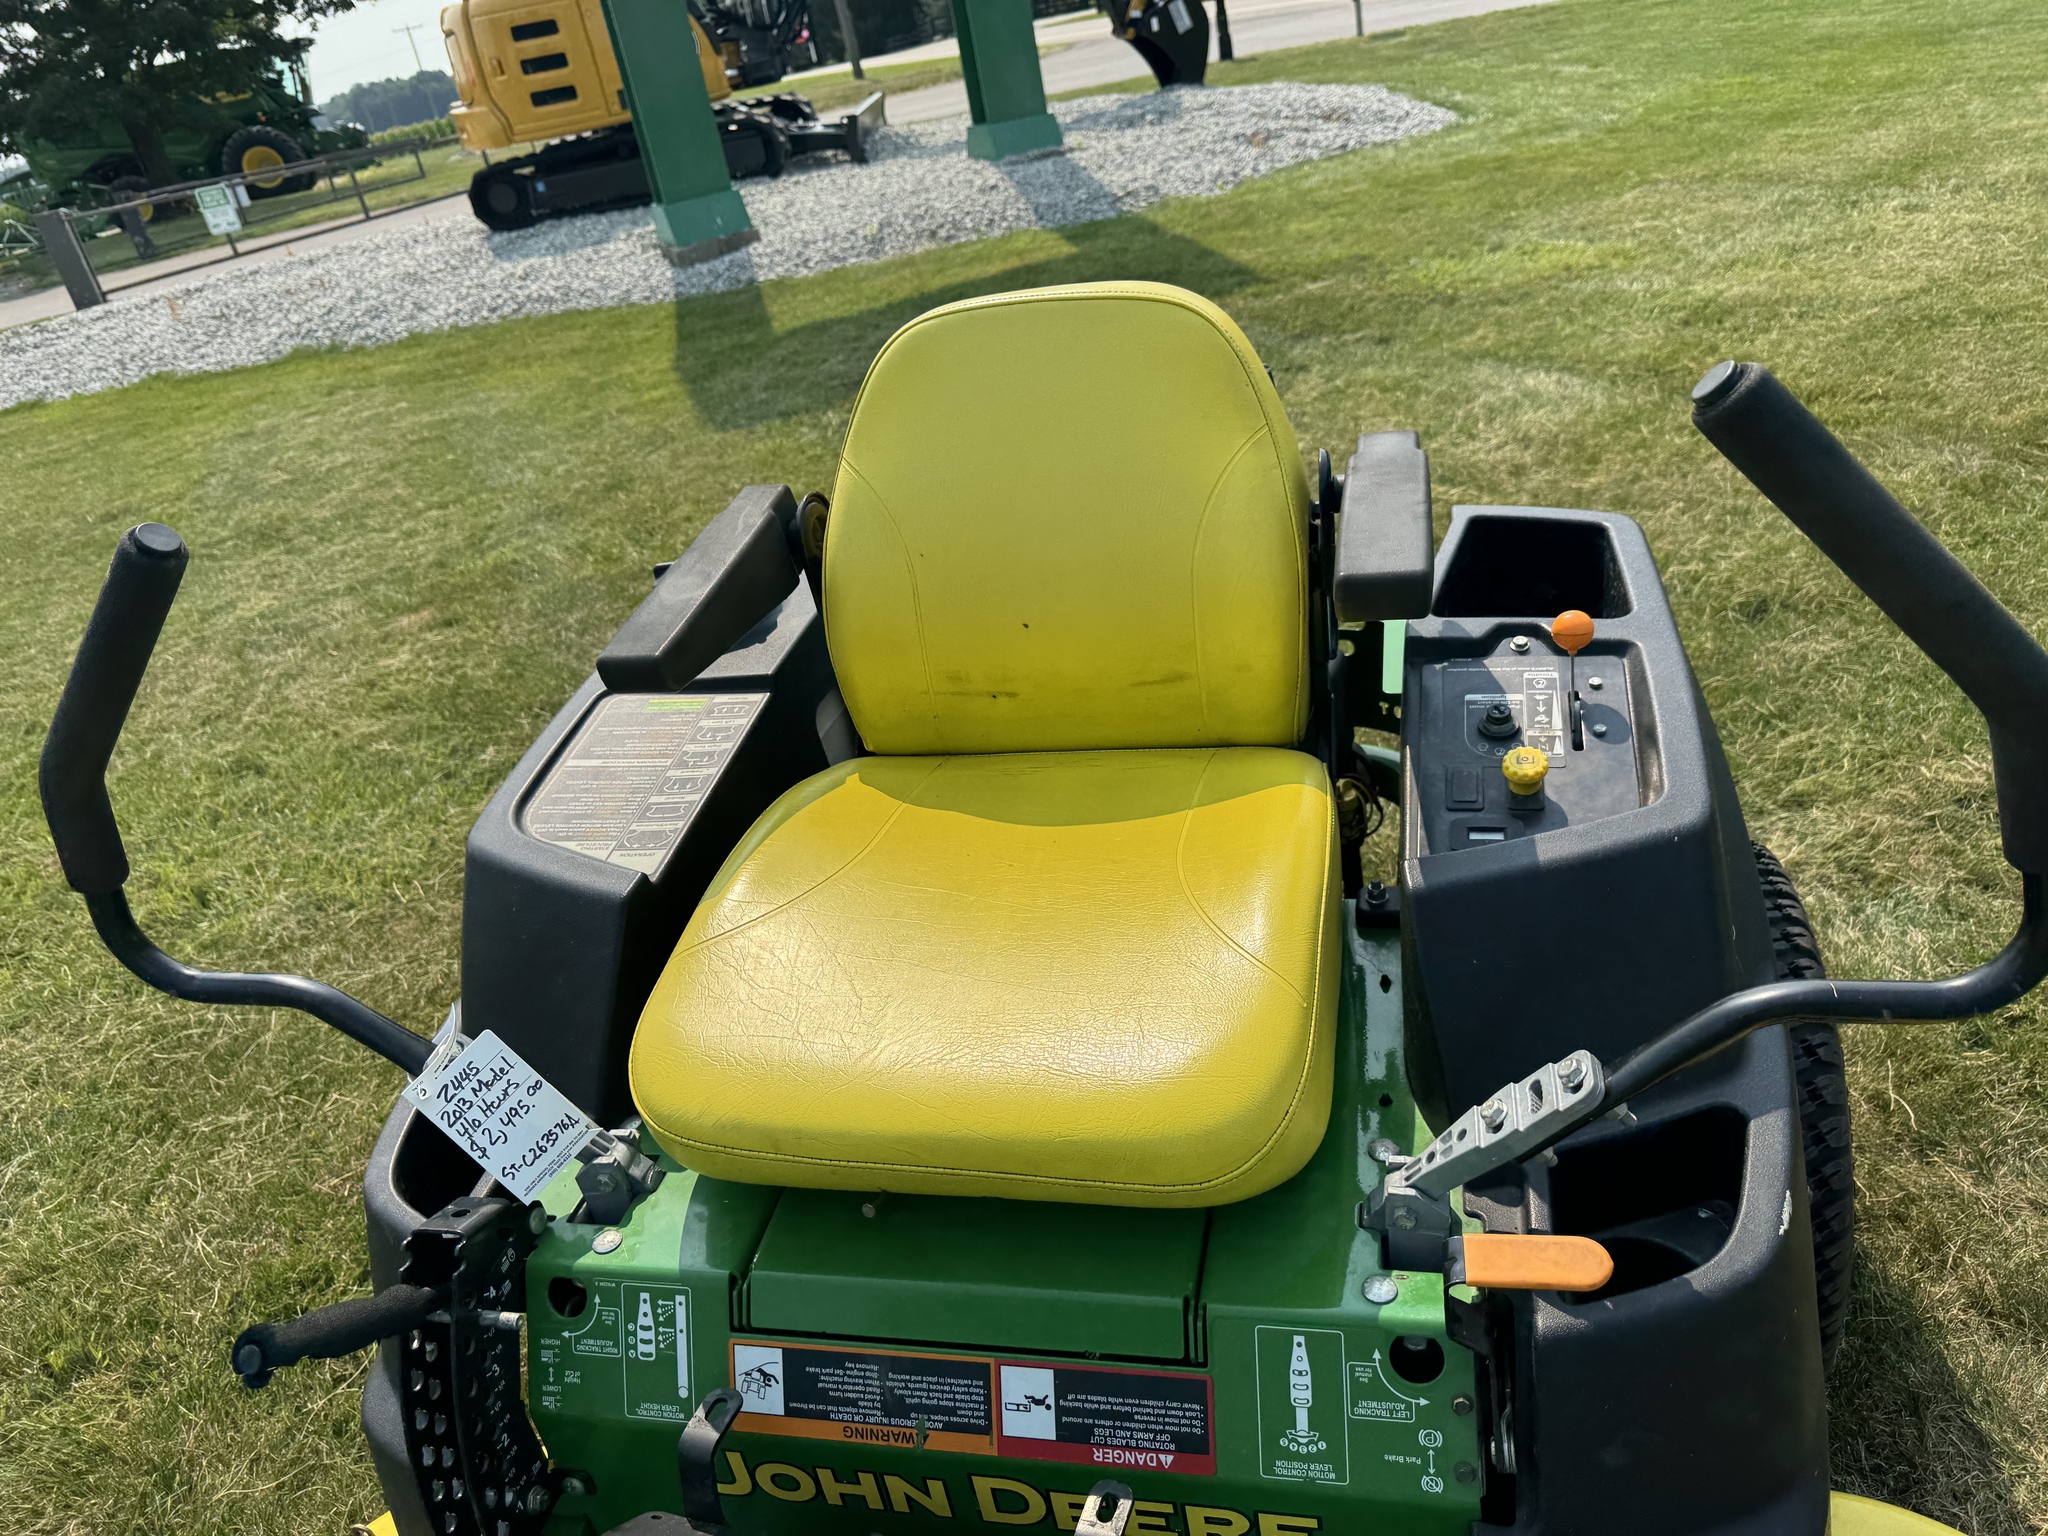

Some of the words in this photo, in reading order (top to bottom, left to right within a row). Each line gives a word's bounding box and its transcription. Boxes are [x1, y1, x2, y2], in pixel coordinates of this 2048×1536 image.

[440, 1097, 473, 1128] 2013
[470, 1055, 514, 1097] Model
[476, 1078, 519, 1118] Hours
[540, 1338, 560, 1346] HIGHER
[580, 1338, 613, 1346] ADJUSTMENT
[576, 1344, 601, 1352] TRACKING
[603, 1345, 617, 1353] RIGHT
[492, 1363, 500, 1376] 3
[564, 1376, 580, 1384] Height
[844, 1376, 863, 1385] leaving
[818, 1382, 837, 1390] manual
[838, 1383, 865, 1393] operator's
[866, 1386, 880, 1394] Read
[844, 1392, 864, 1400] sudden
[1067, 1393, 1076, 1401] off
[1087, 1395, 1106, 1403] blades
[874, 1401, 880, 1409] by
[1059, 1399, 1082, 1409] backing
[1108, 1397, 1123, 1405] while
[1140, 1399, 1164, 1408] children
[1166, 1400, 1180, 1408] carry
[1357, 1400, 1405, 1410] ADJUSTMENT
[640, 1402, 660, 1411] HEIGHT
[661, 1404, 679, 1413] LEVER
[1084, 1403, 1098, 1411] while
[1110, 1405, 1131, 1413] before
[1133, 1407, 1153, 1415] behind
[1182, 1403, 1199, 1411] Never
[636, 1409, 662, 1418] CONTROL
[663, 1411, 684, 1420] MOTION
[957, 1409, 972, 1417] down
[1167, 1410, 1183, 1418] down
[1185, 1411, 1200, 1419] Look
[1353, 1407, 1390, 1417] TRACKING
[1392, 1410, 1409, 1418] LEFT
[830, 1412, 852, 1422] DEATH
[854, 1414, 863, 1422] OR
[865, 1415, 889, 1425] INJURY
[1062, 1416, 1082, 1424] around
[1094, 1419, 1113, 1427] others
[1122, 1421, 1146, 1430] children
[843, 1426, 915, 1445] WARNING
[1094, 1428, 1113, 1437] LEGS
[1115, 1429, 1131, 1439] AND
[1133, 1431, 1154, 1440] ARMS
[501, 1433, 510, 1447] 2
[1090, 1436, 1105, 1445] CUT
[1156, 1433, 1170, 1442] OFF
[1108, 1438, 1136, 1448] BLADES
[1138, 1440, 1175, 1451] ROTATING
[1092, 1448, 1156, 1466] DANGER
[1383, 1454, 1403, 1462] Brake
[1405, 1456, 1421, 1464] Park
[1275, 1460, 1308, 1470] POSITION
[1309, 1462, 1332, 1471] LEVER
[1273, 1467, 1306, 1477] CONTROL
[1308, 1470, 1335, 1479] MOTION
[717, 1451, 953, 1518] JOHN
